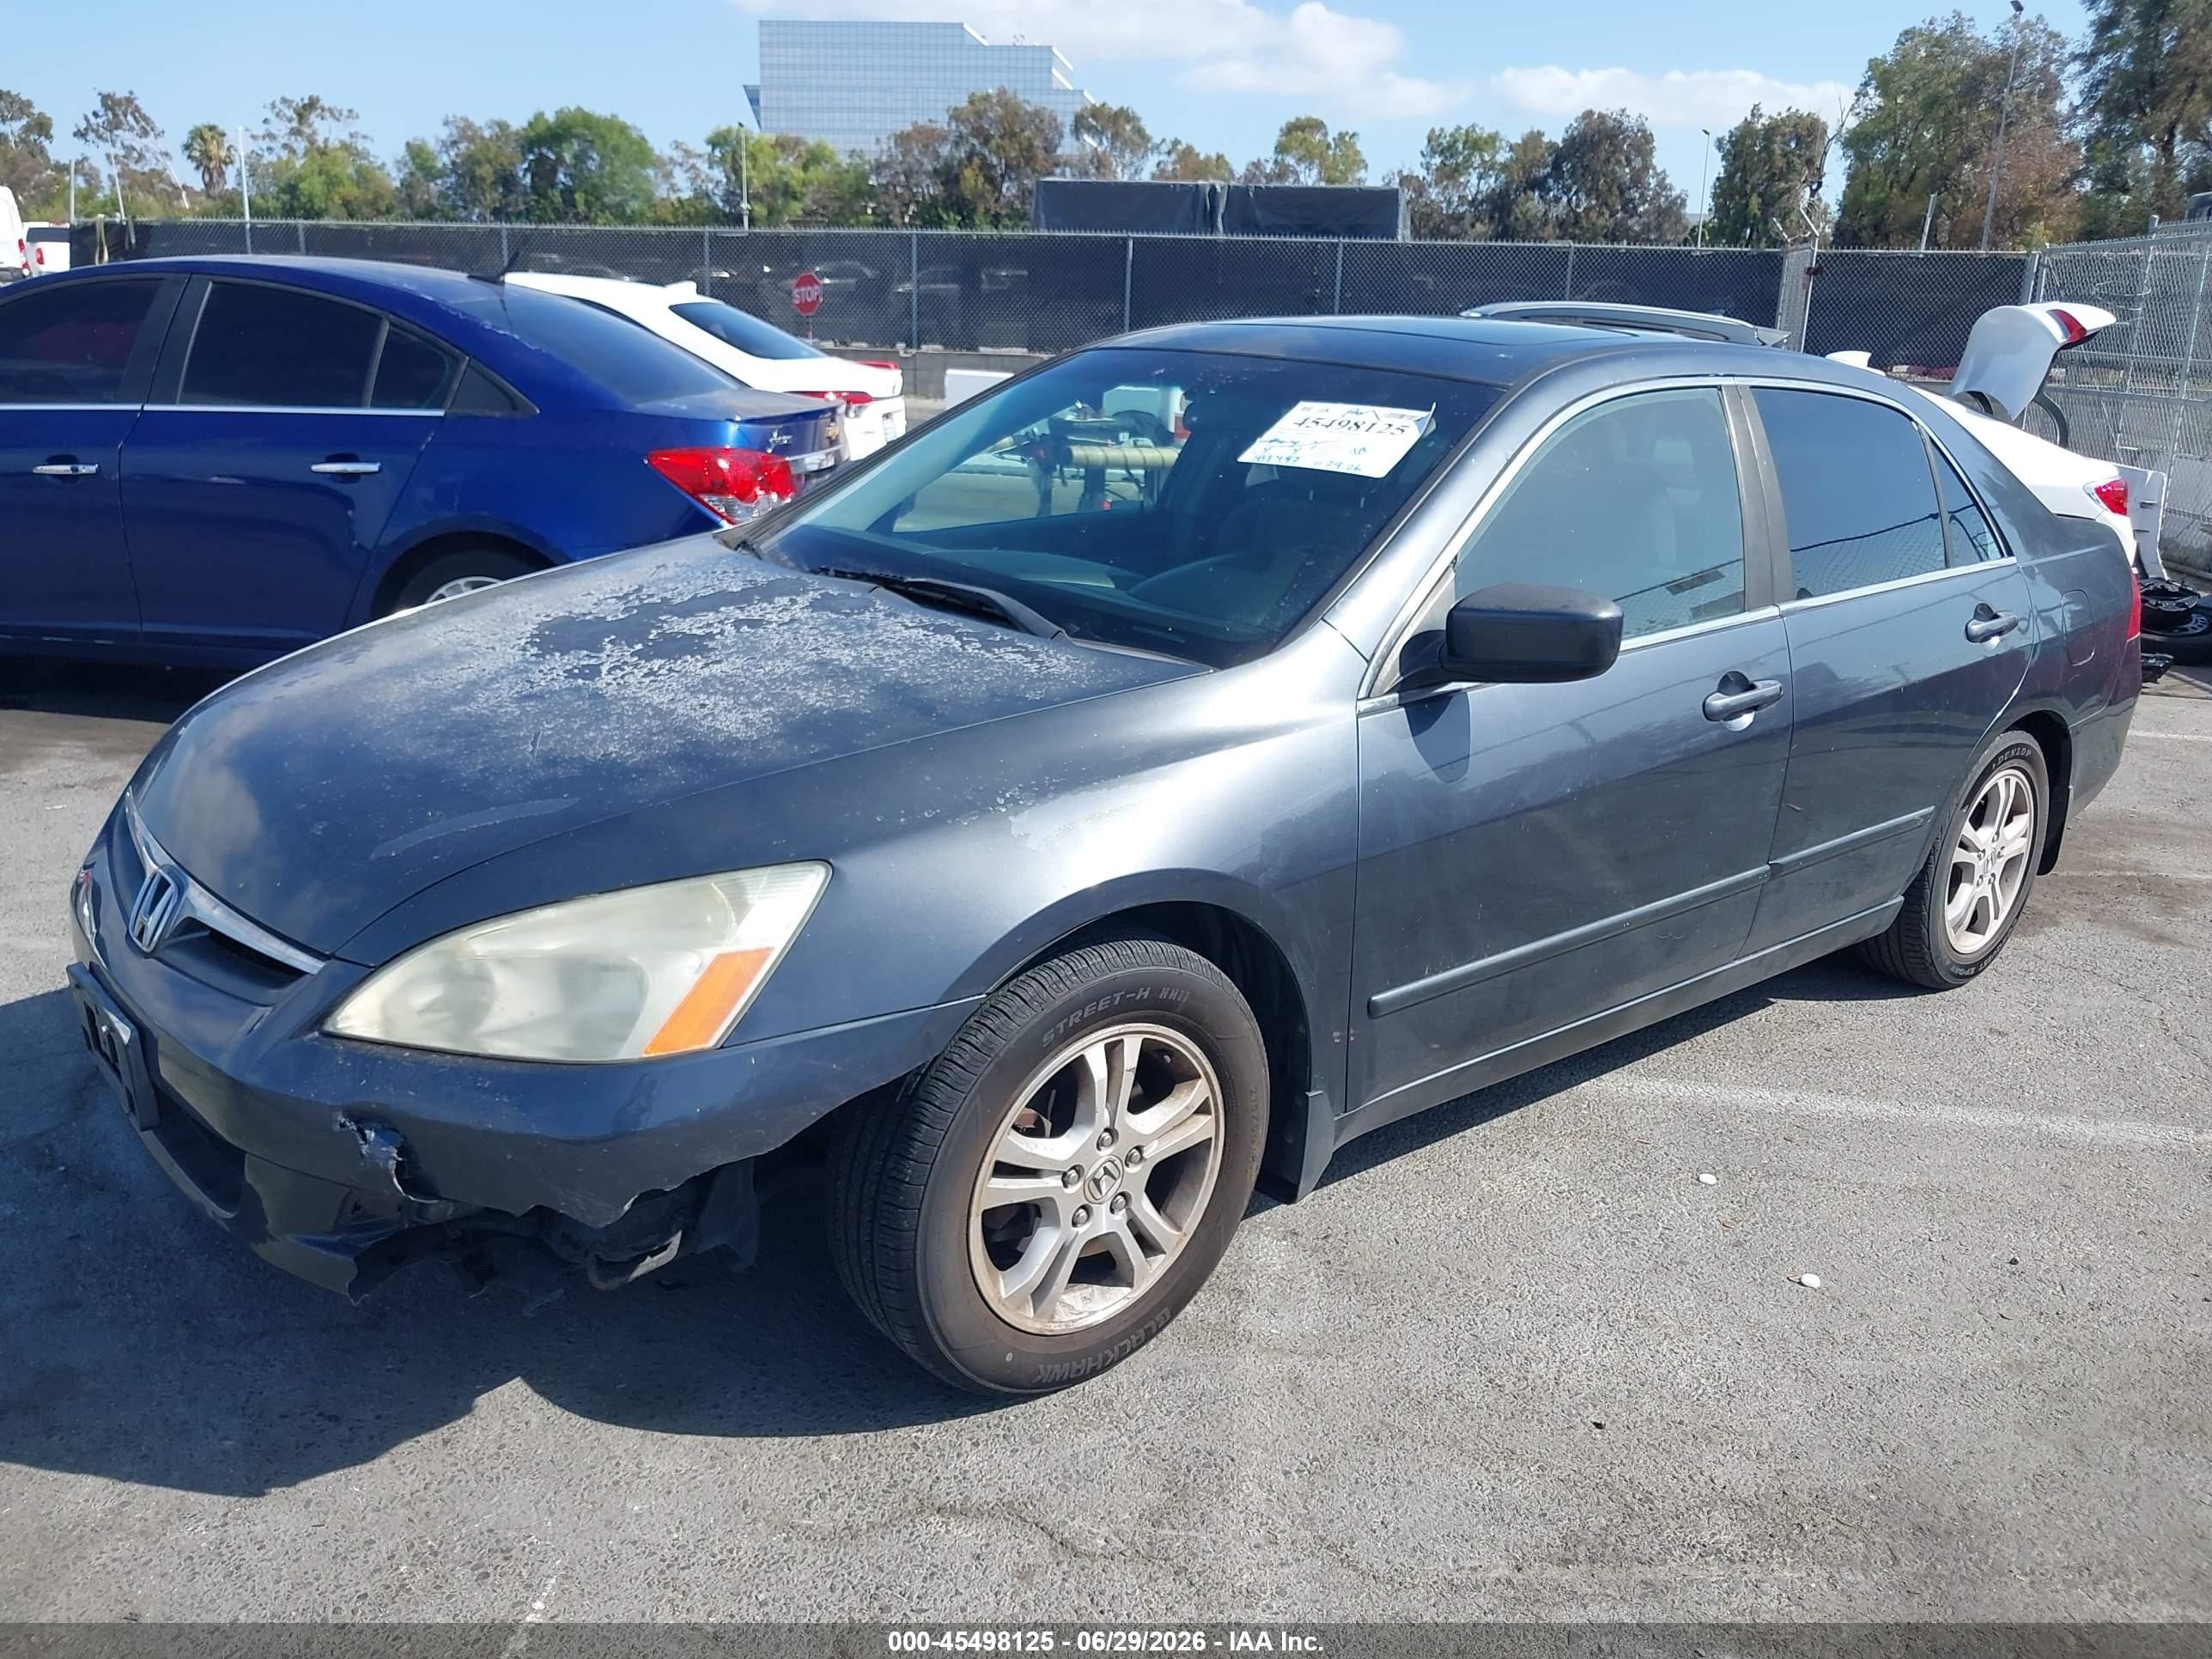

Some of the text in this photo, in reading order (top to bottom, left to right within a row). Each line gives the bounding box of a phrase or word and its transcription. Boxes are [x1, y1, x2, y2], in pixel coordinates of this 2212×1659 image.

[793, 286, 821, 304] STOP
[1293, 416, 1411, 436] 45498125
[1042, 987, 1152, 1048] STREET-H
[1031, 1306, 1172, 1384] BLACKHAWK
